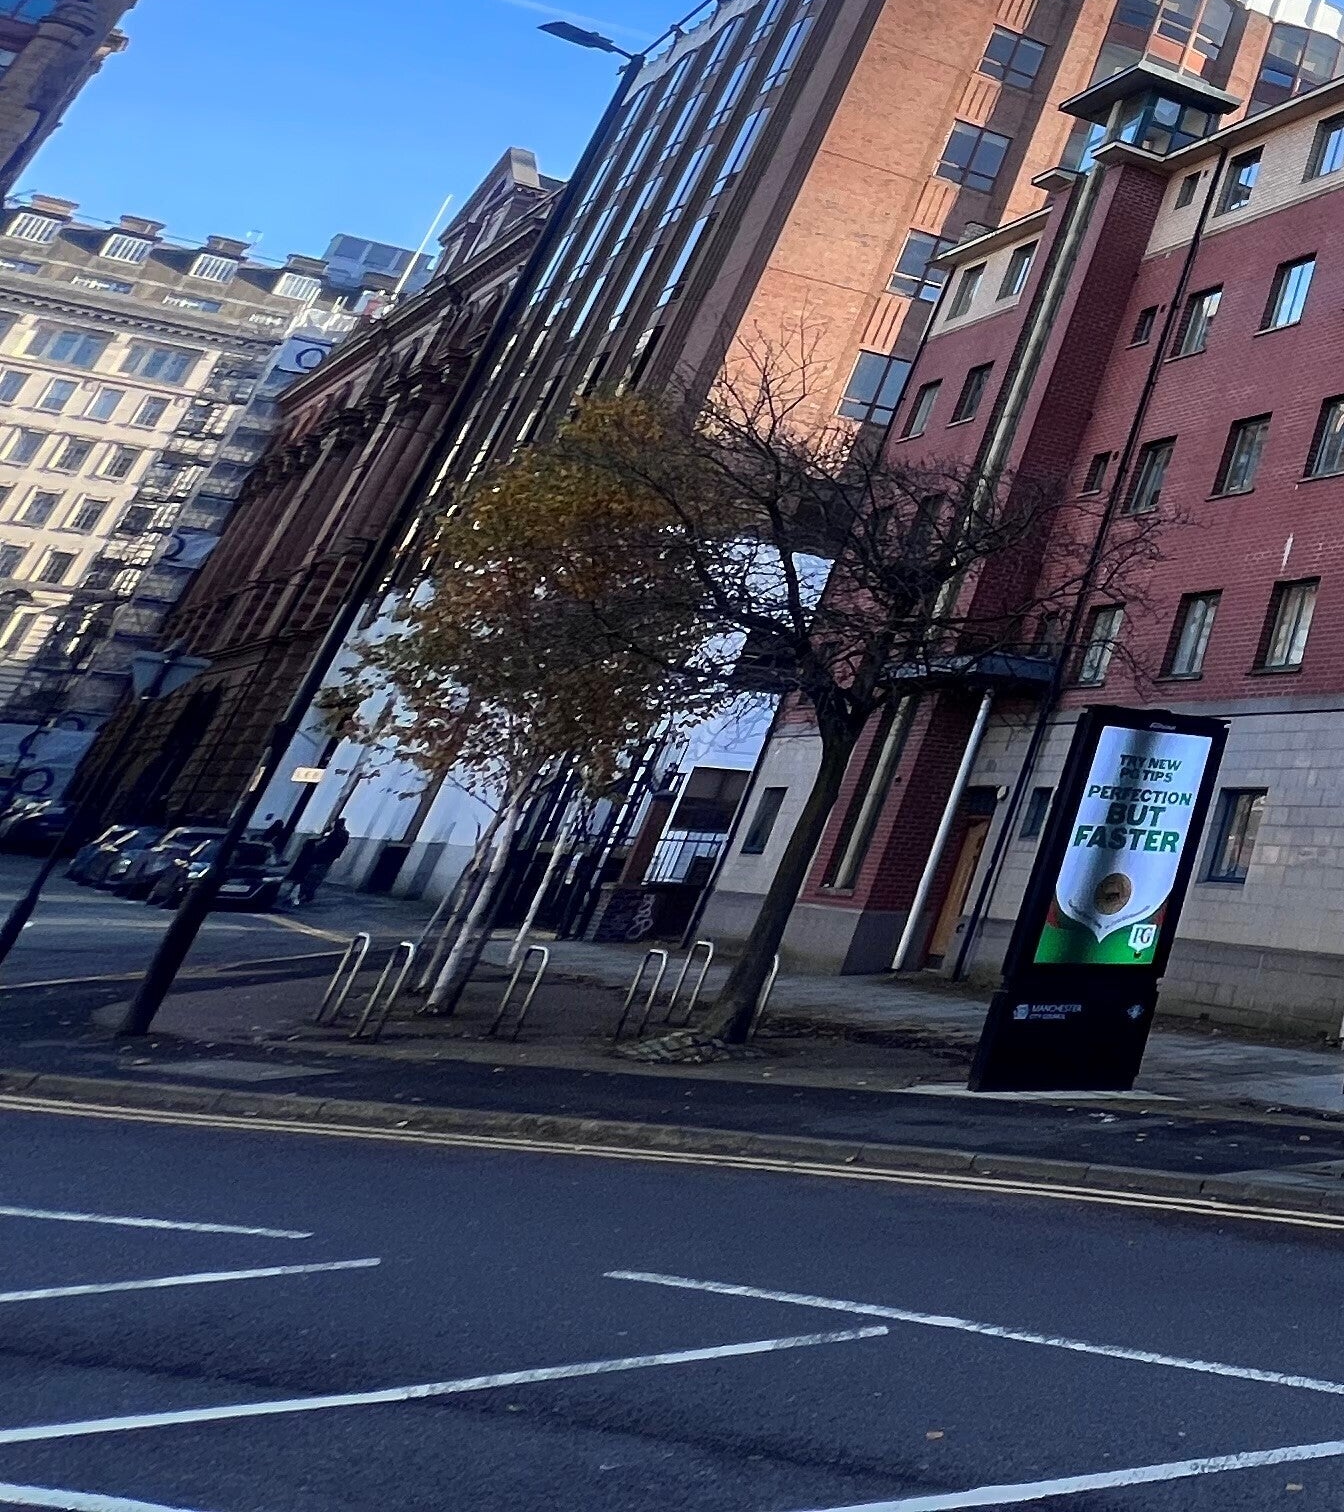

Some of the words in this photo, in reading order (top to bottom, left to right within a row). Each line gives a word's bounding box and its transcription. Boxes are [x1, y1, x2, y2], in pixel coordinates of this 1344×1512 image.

[1120, 754, 1146, 769] TRY
[1148, 757, 1182, 771] NEW
[1143, 769, 1174, 783] TIPS
[1087, 785, 1192, 806] PERFECTION
[1105, 802, 1166, 827] BUT
[1073, 825, 1180, 853] FASTER
